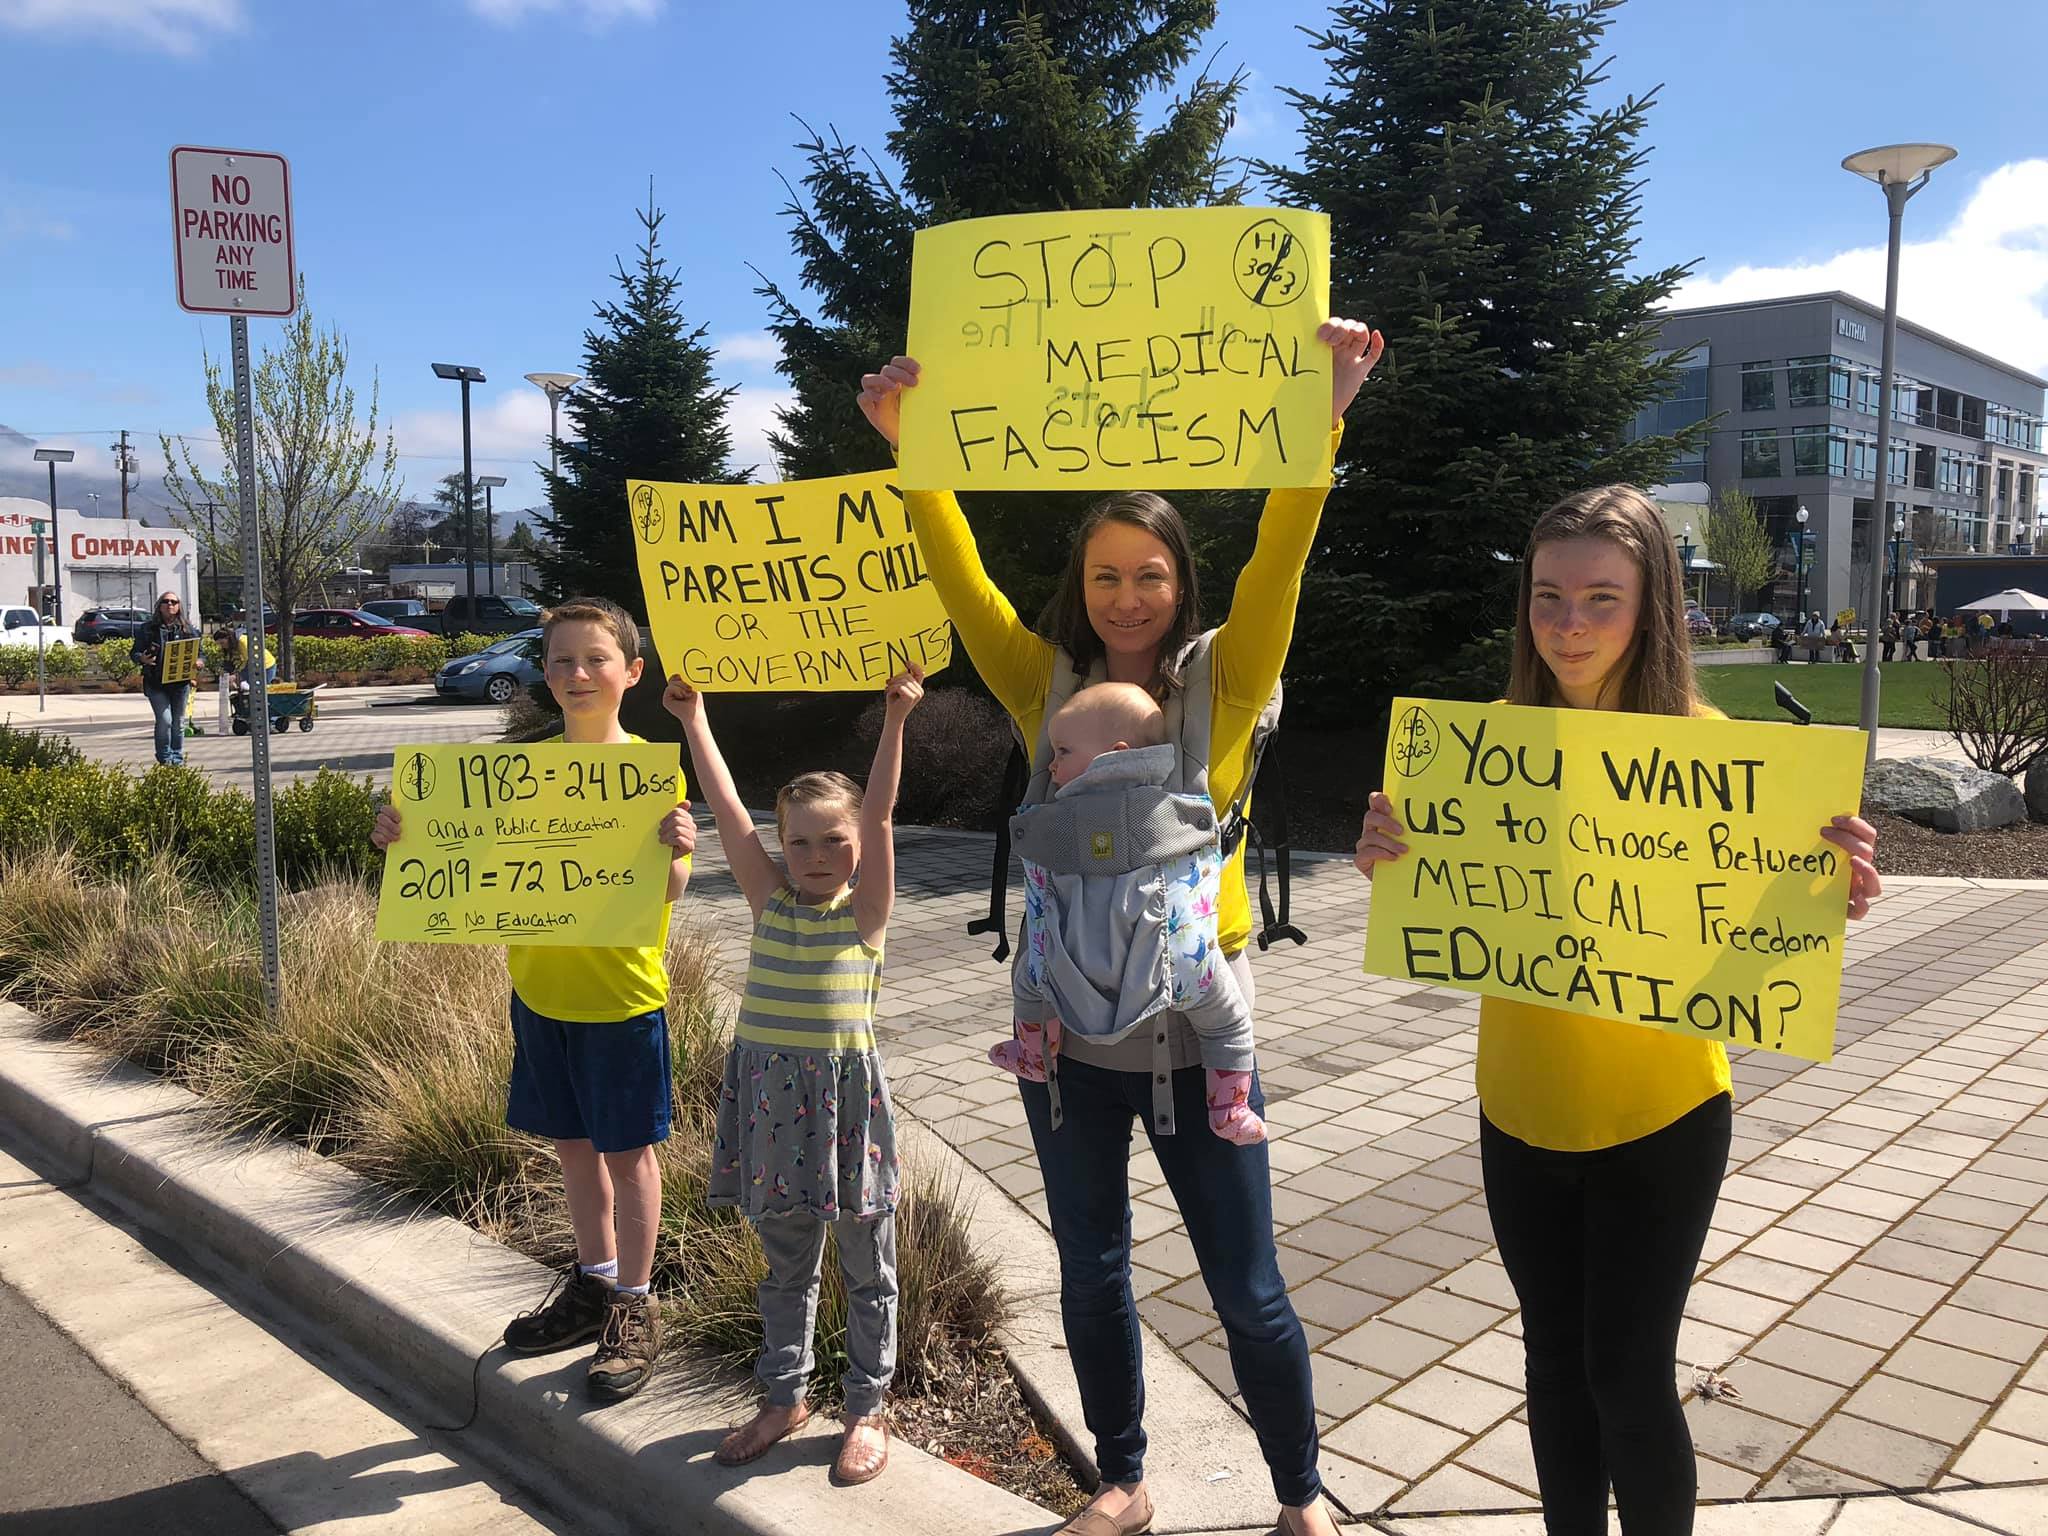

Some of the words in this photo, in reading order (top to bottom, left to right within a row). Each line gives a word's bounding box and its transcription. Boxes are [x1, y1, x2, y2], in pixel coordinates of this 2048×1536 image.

[211, 174, 251, 206] NO
[183, 208, 282, 244] PARKING
[215, 245, 255, 266] ANY
[973, 234, 1187, 309] STOP
[215, 269, 258, 291] TIME
[1242, 257, 1297, 296] 3063
[1845, 320, 1867, 342] LITHIA
[1045, 329, 1321, 384] MEDICAL
[950, 406, 1289, 473] FASCISM
[679, 499, 738, 544] AM
[755, 495, 802, 545] I
[71, 533, 181, 560] COMPANY
[660, 554, 847, 604] PARENTS
[857, 541, 931, 593] CHIL
[715, 613, 768, 641] OR
[788, 605, 875, 640] THE
[1402, 719, 1427, 737] HB
[1396, 739, 1432, 761] 3063
[1449, 718, 1563, 791] YOU
[1601, 747, 1765, 814] WANT
[459, 753, 538, 809] 1983
[564, 761, 608, 801] 24
[619, 762, 677, 801] Doses
[495, 816, 541, 837] Public
[1496, 803, 1547, 845] to
[1568, 813, 1690, 861] Choose
[1708, 822, 1836, 877] Between
[399, 858, 470, 900] 2019
[504, 860, 545, 893] 72
[560, 859, 635, 893] Doses
[427, 913, 450, 929] OR
[465, 910, 486, 927] No
[496, 911, 577, 931] Education
[1413, 857, 1668, 940] MEDICAL
[1695, 882, 1830, 956] Freedom
[1555, 934, 1603, 963] OR
